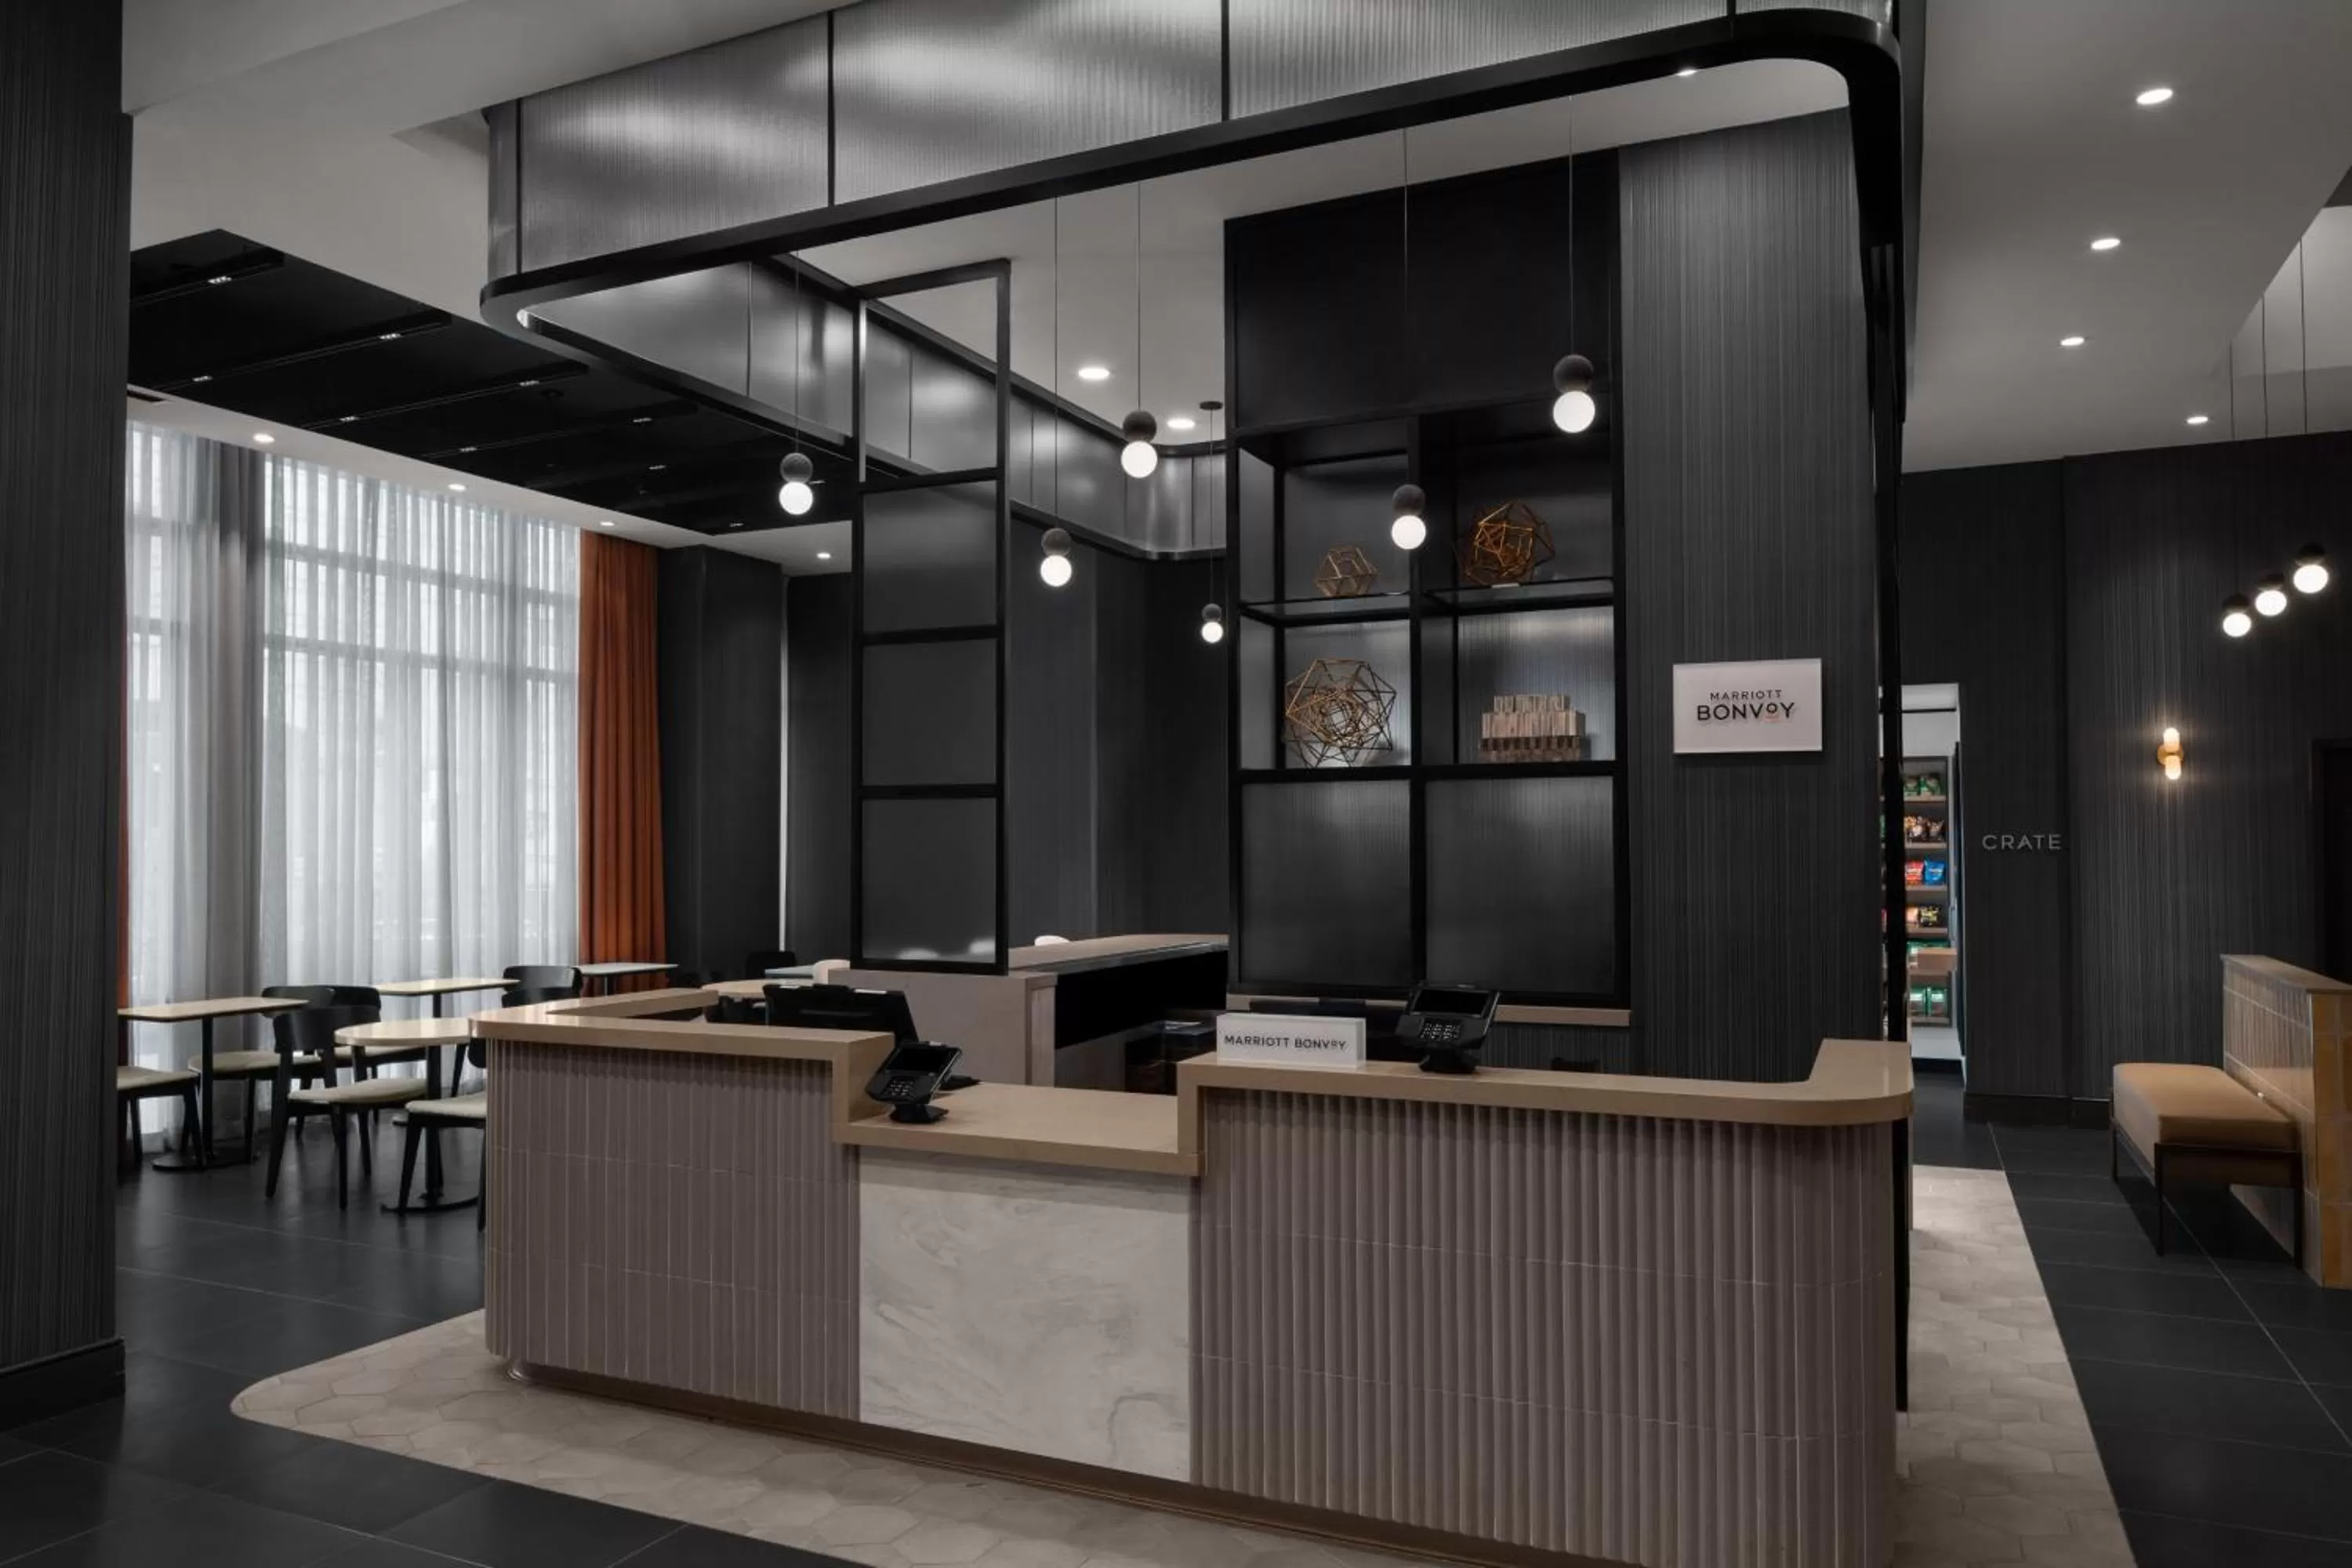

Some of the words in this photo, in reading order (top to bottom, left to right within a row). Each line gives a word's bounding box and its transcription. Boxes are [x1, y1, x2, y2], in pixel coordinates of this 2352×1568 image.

[1709, 689, 1783, 701] MARRIOTT
[1982, 833, 2061, 851] CRATE
[1225, 1035, 1290, 1048] MARRIOTT
